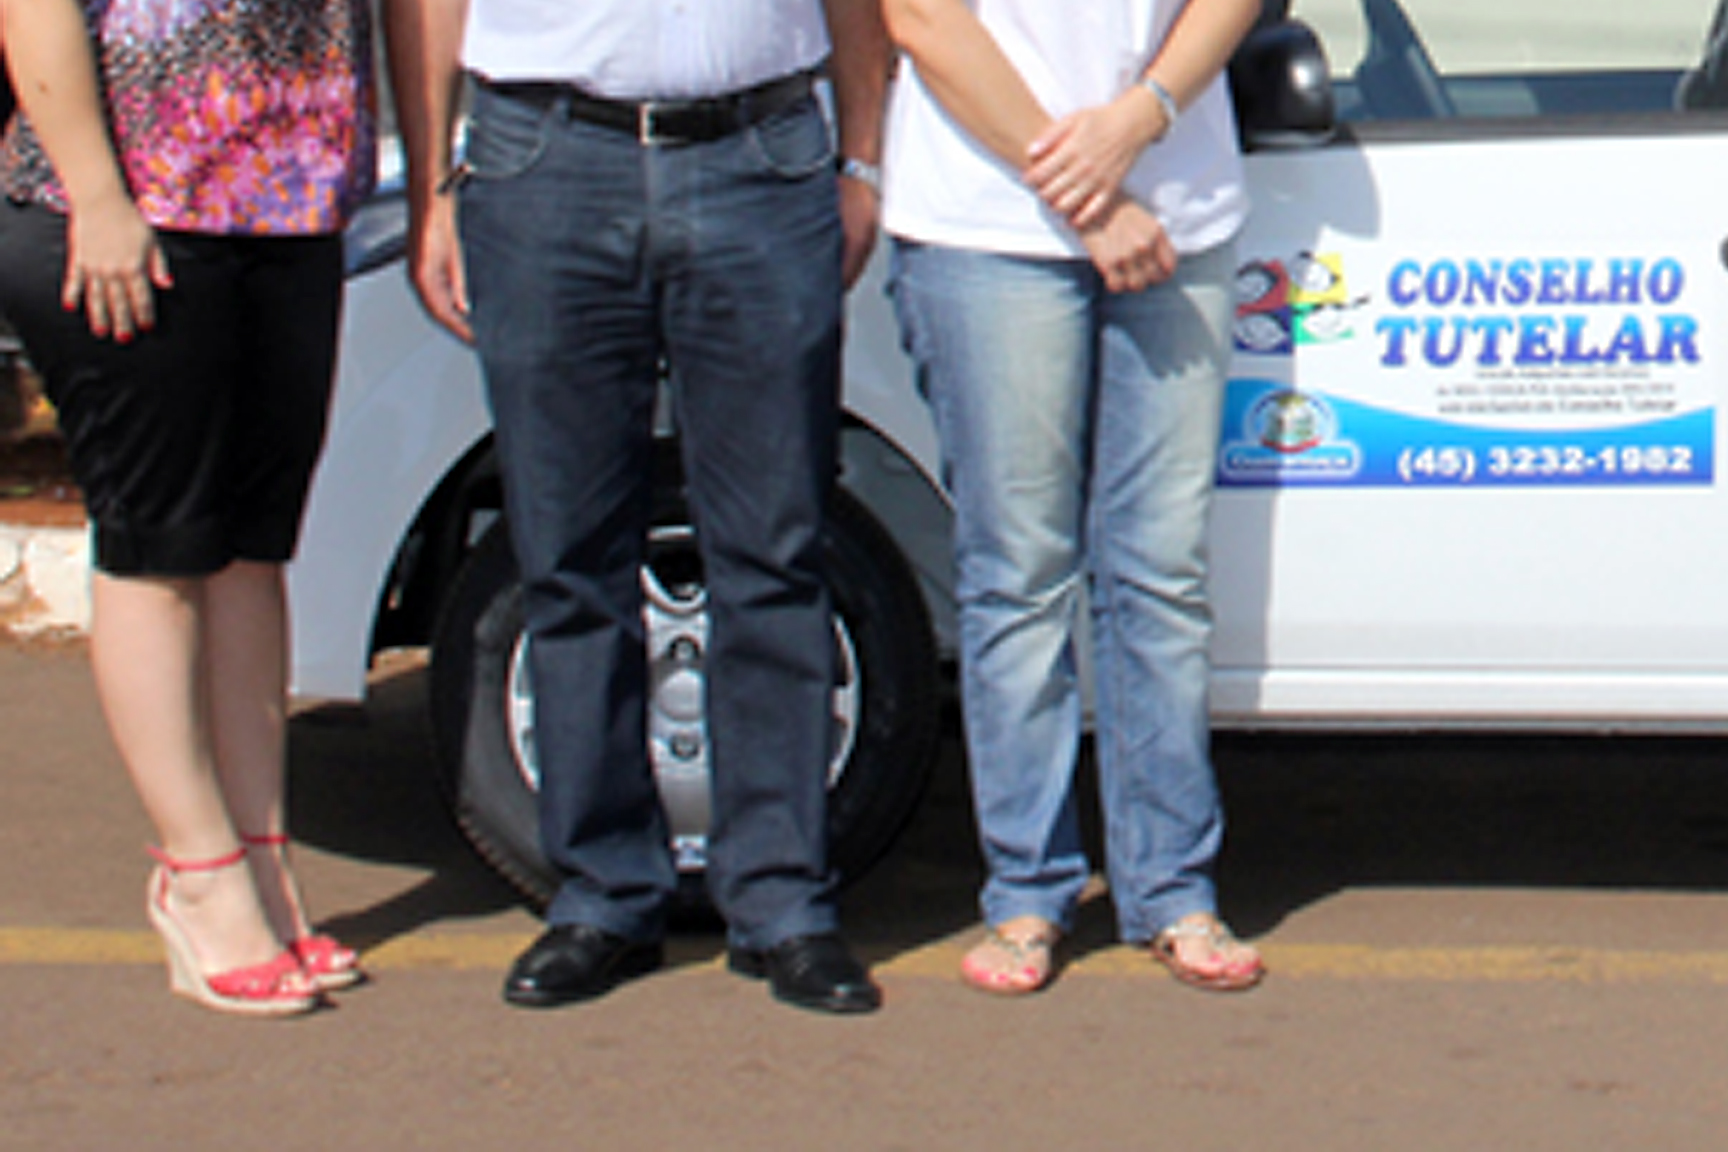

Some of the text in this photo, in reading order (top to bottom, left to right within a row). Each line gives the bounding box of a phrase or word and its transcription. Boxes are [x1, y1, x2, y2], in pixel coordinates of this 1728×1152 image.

[1388, 258, 1684, 306] CONSELHO
[1375, 315, 1700, 368] TUTELAR
[1397, 447, 1477, 482] (45)
[1487, 446, 1693, 477] 3232-1982
